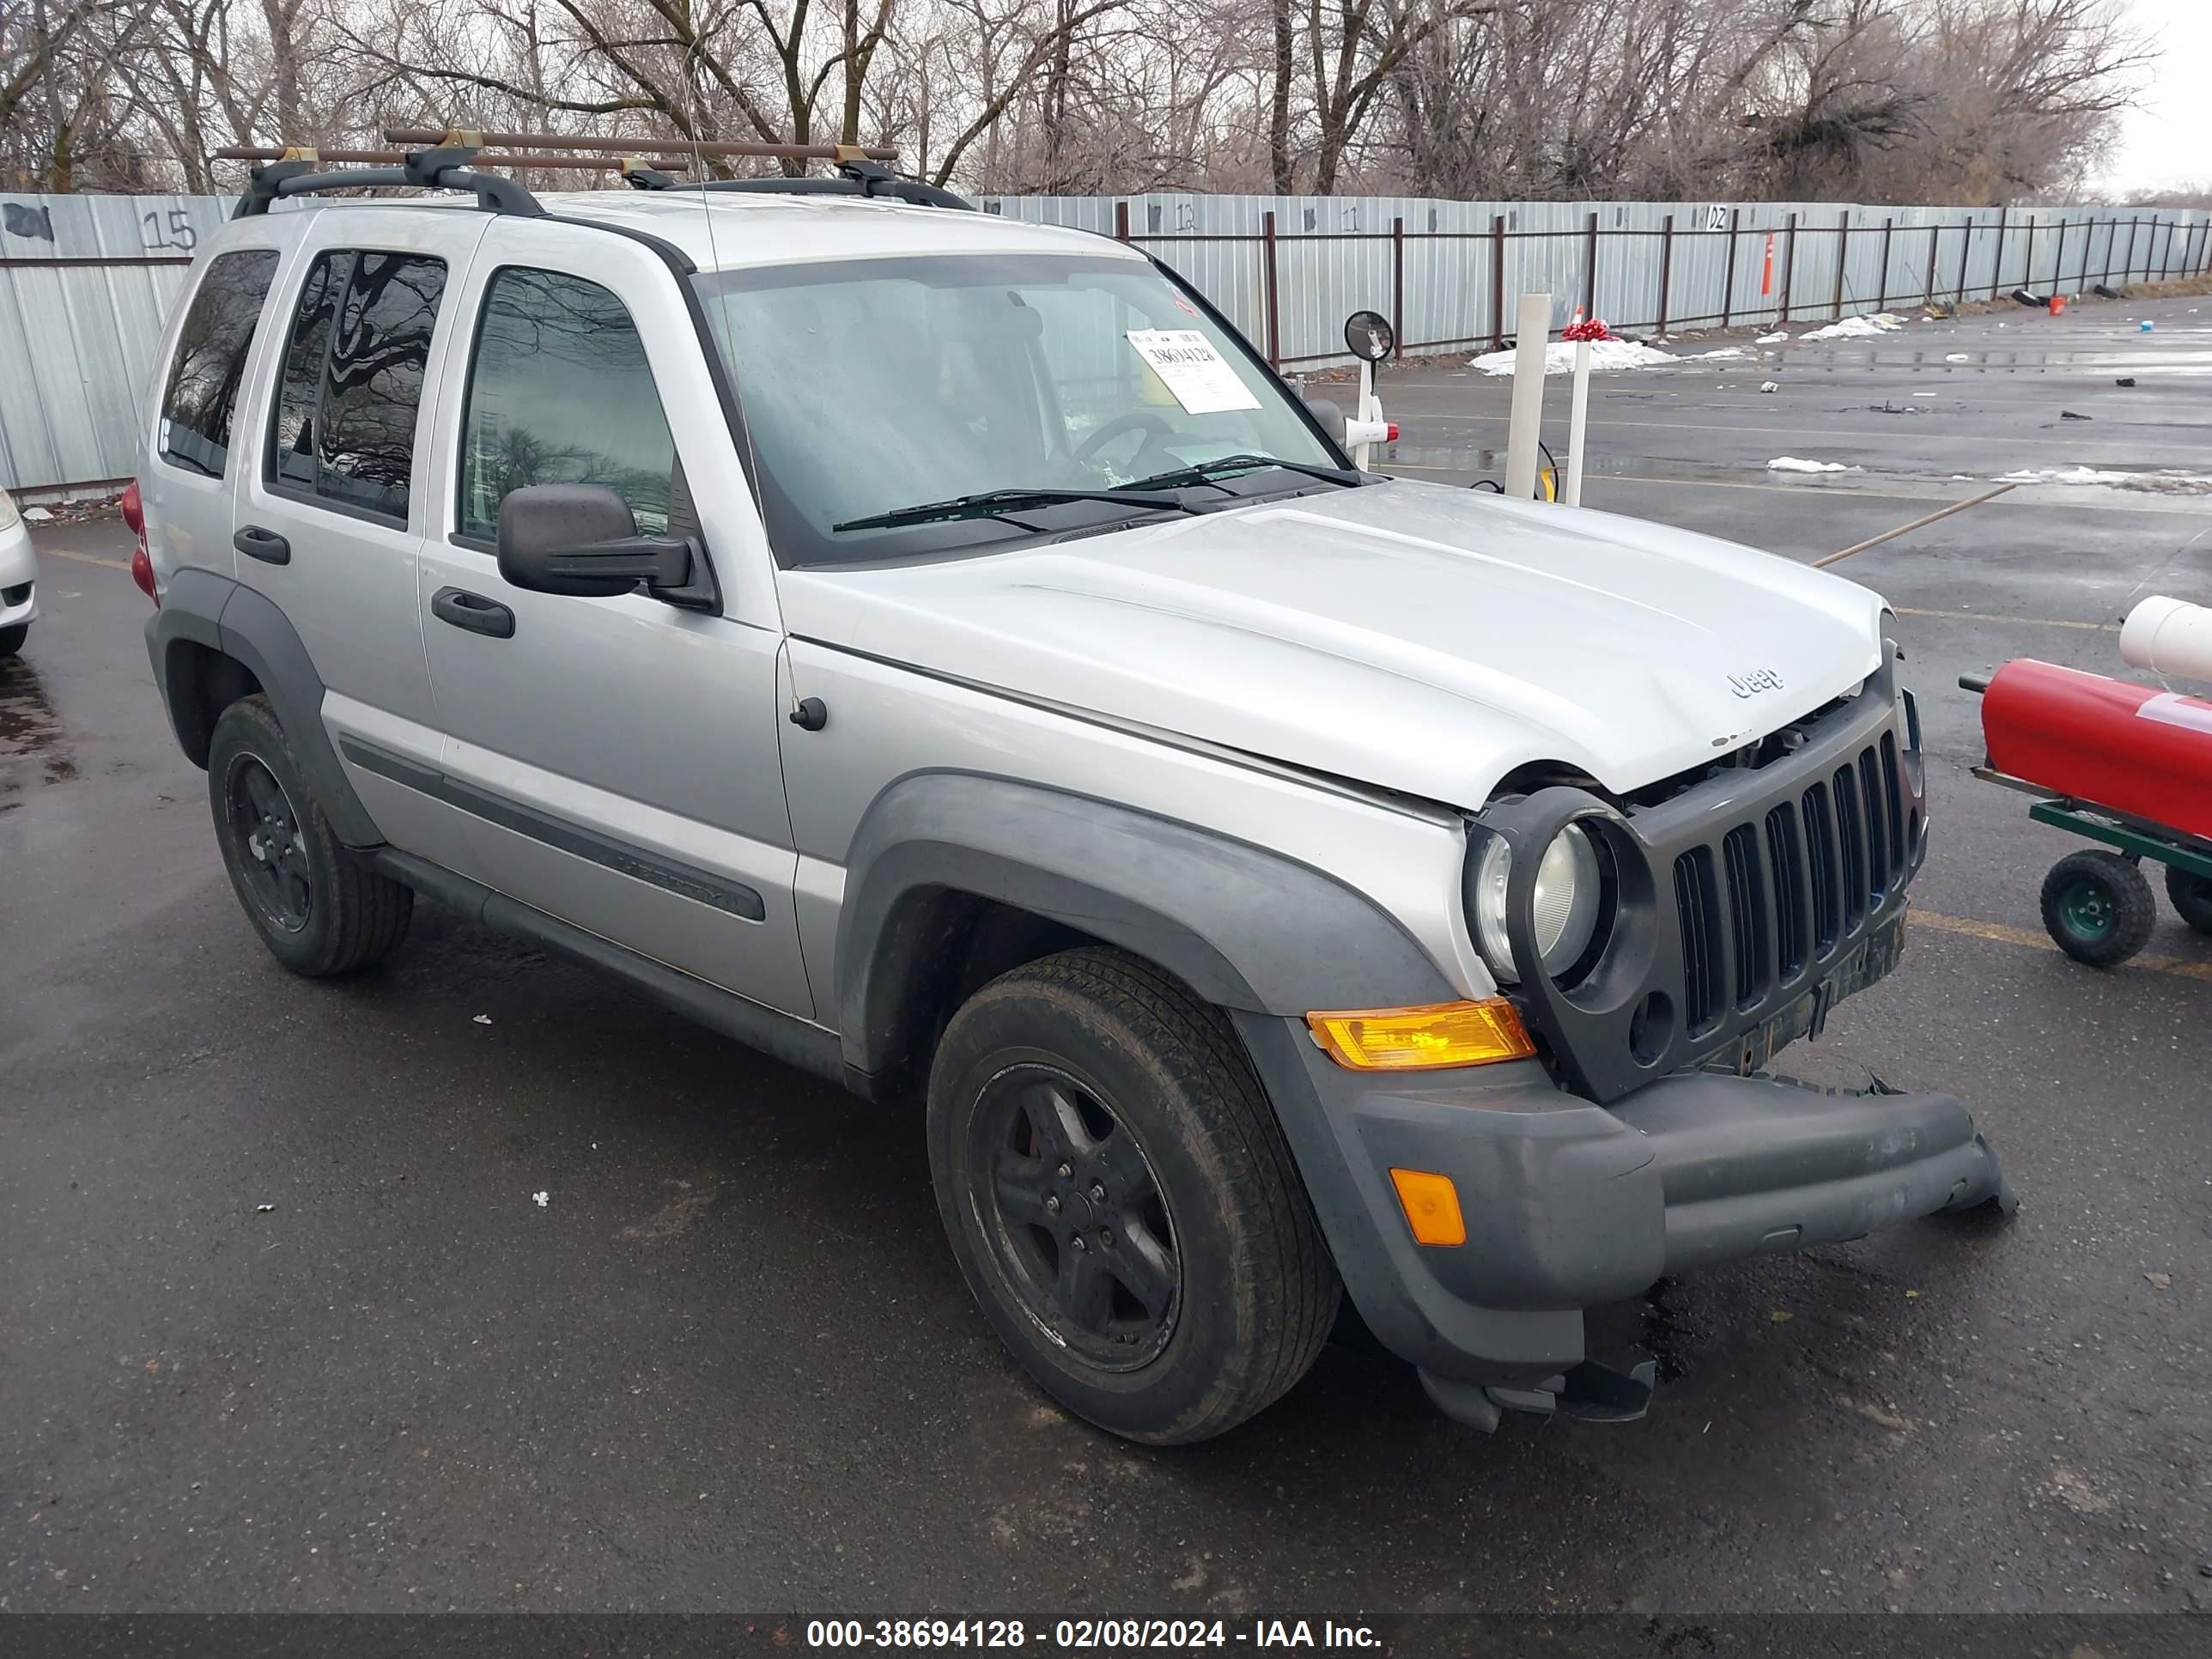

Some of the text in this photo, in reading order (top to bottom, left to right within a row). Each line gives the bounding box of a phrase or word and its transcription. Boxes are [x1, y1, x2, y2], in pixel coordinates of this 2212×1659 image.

[143, 210, 198, 251] 15
[1176, 204, 1198, 230] 12
[1726, 667, 1784, 699] Jeep
